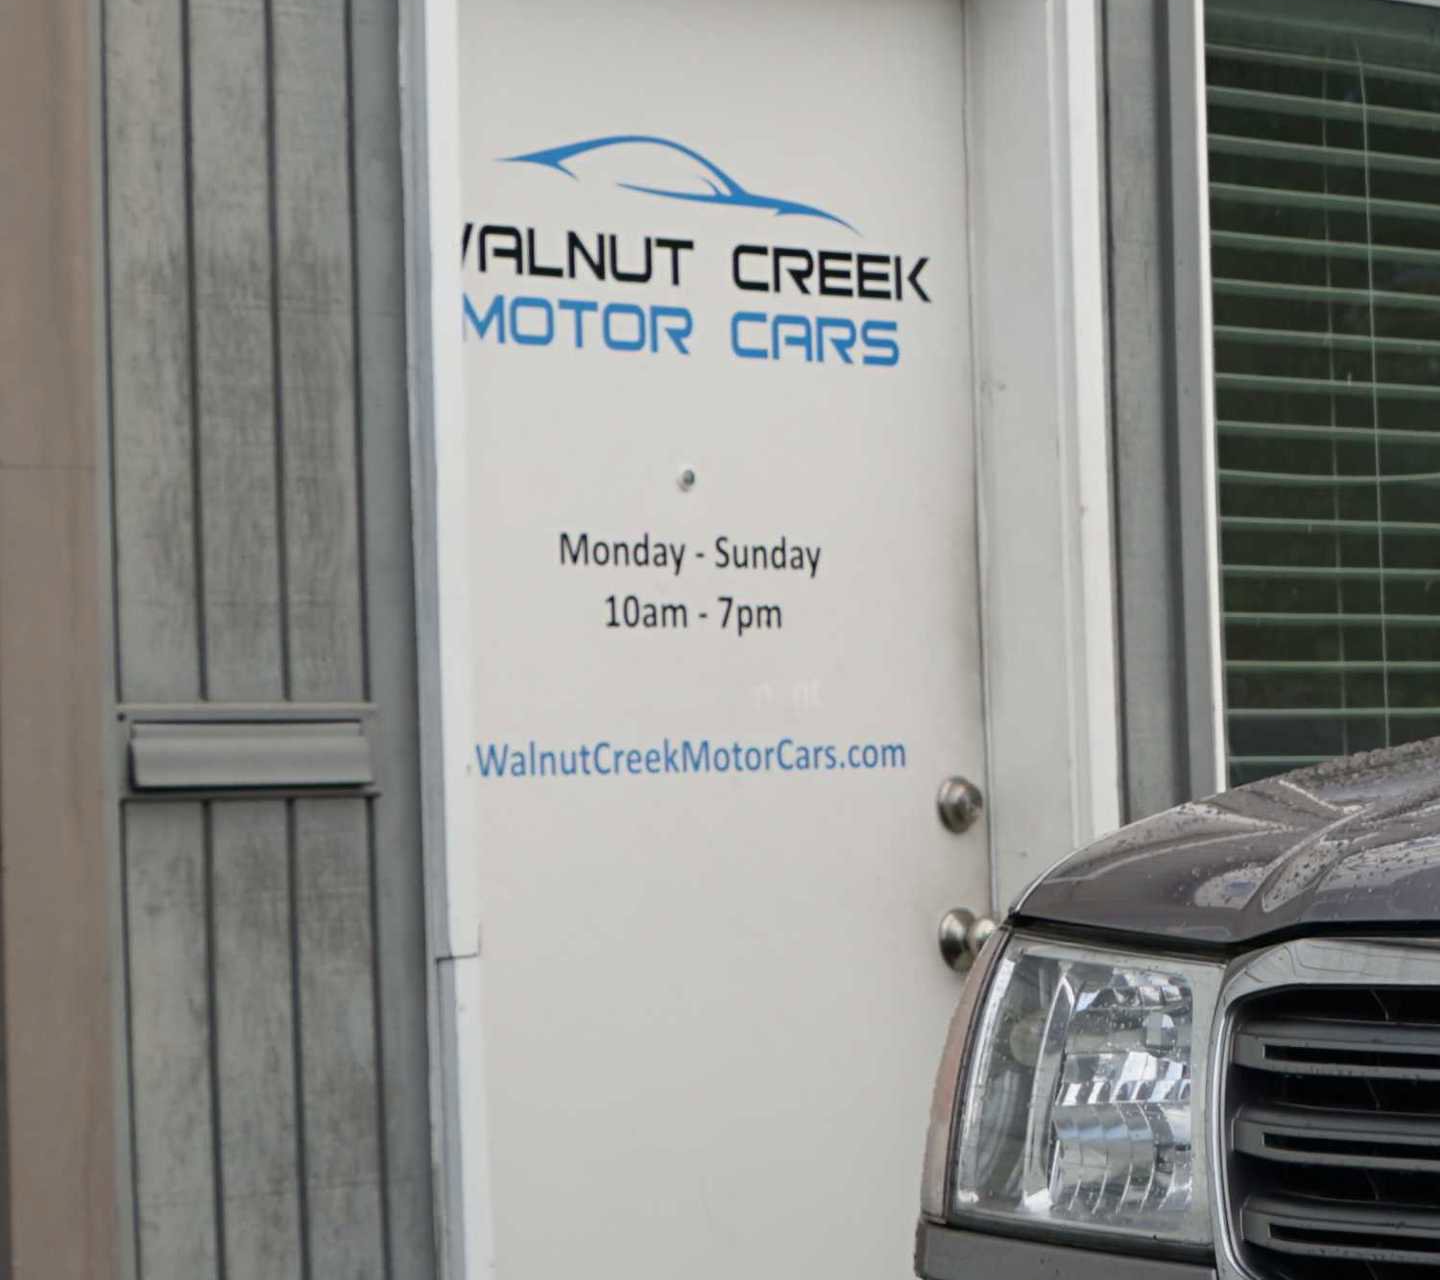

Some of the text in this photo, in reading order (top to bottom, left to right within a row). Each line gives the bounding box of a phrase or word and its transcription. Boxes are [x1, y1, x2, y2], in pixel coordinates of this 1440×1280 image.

[461, 222, 932, 304] ALNUT CREEK
[463, 293, 901, 368] MOTOR CARS
[558, 531, 686, 577] Monday
[714, 534, 822, 579] Sunday
[604, 593, 689, 630] 10am
[716, 595, 783, 638] 7pm
[475, 735, 907, 778] WalnutCreekMotorCars.com
